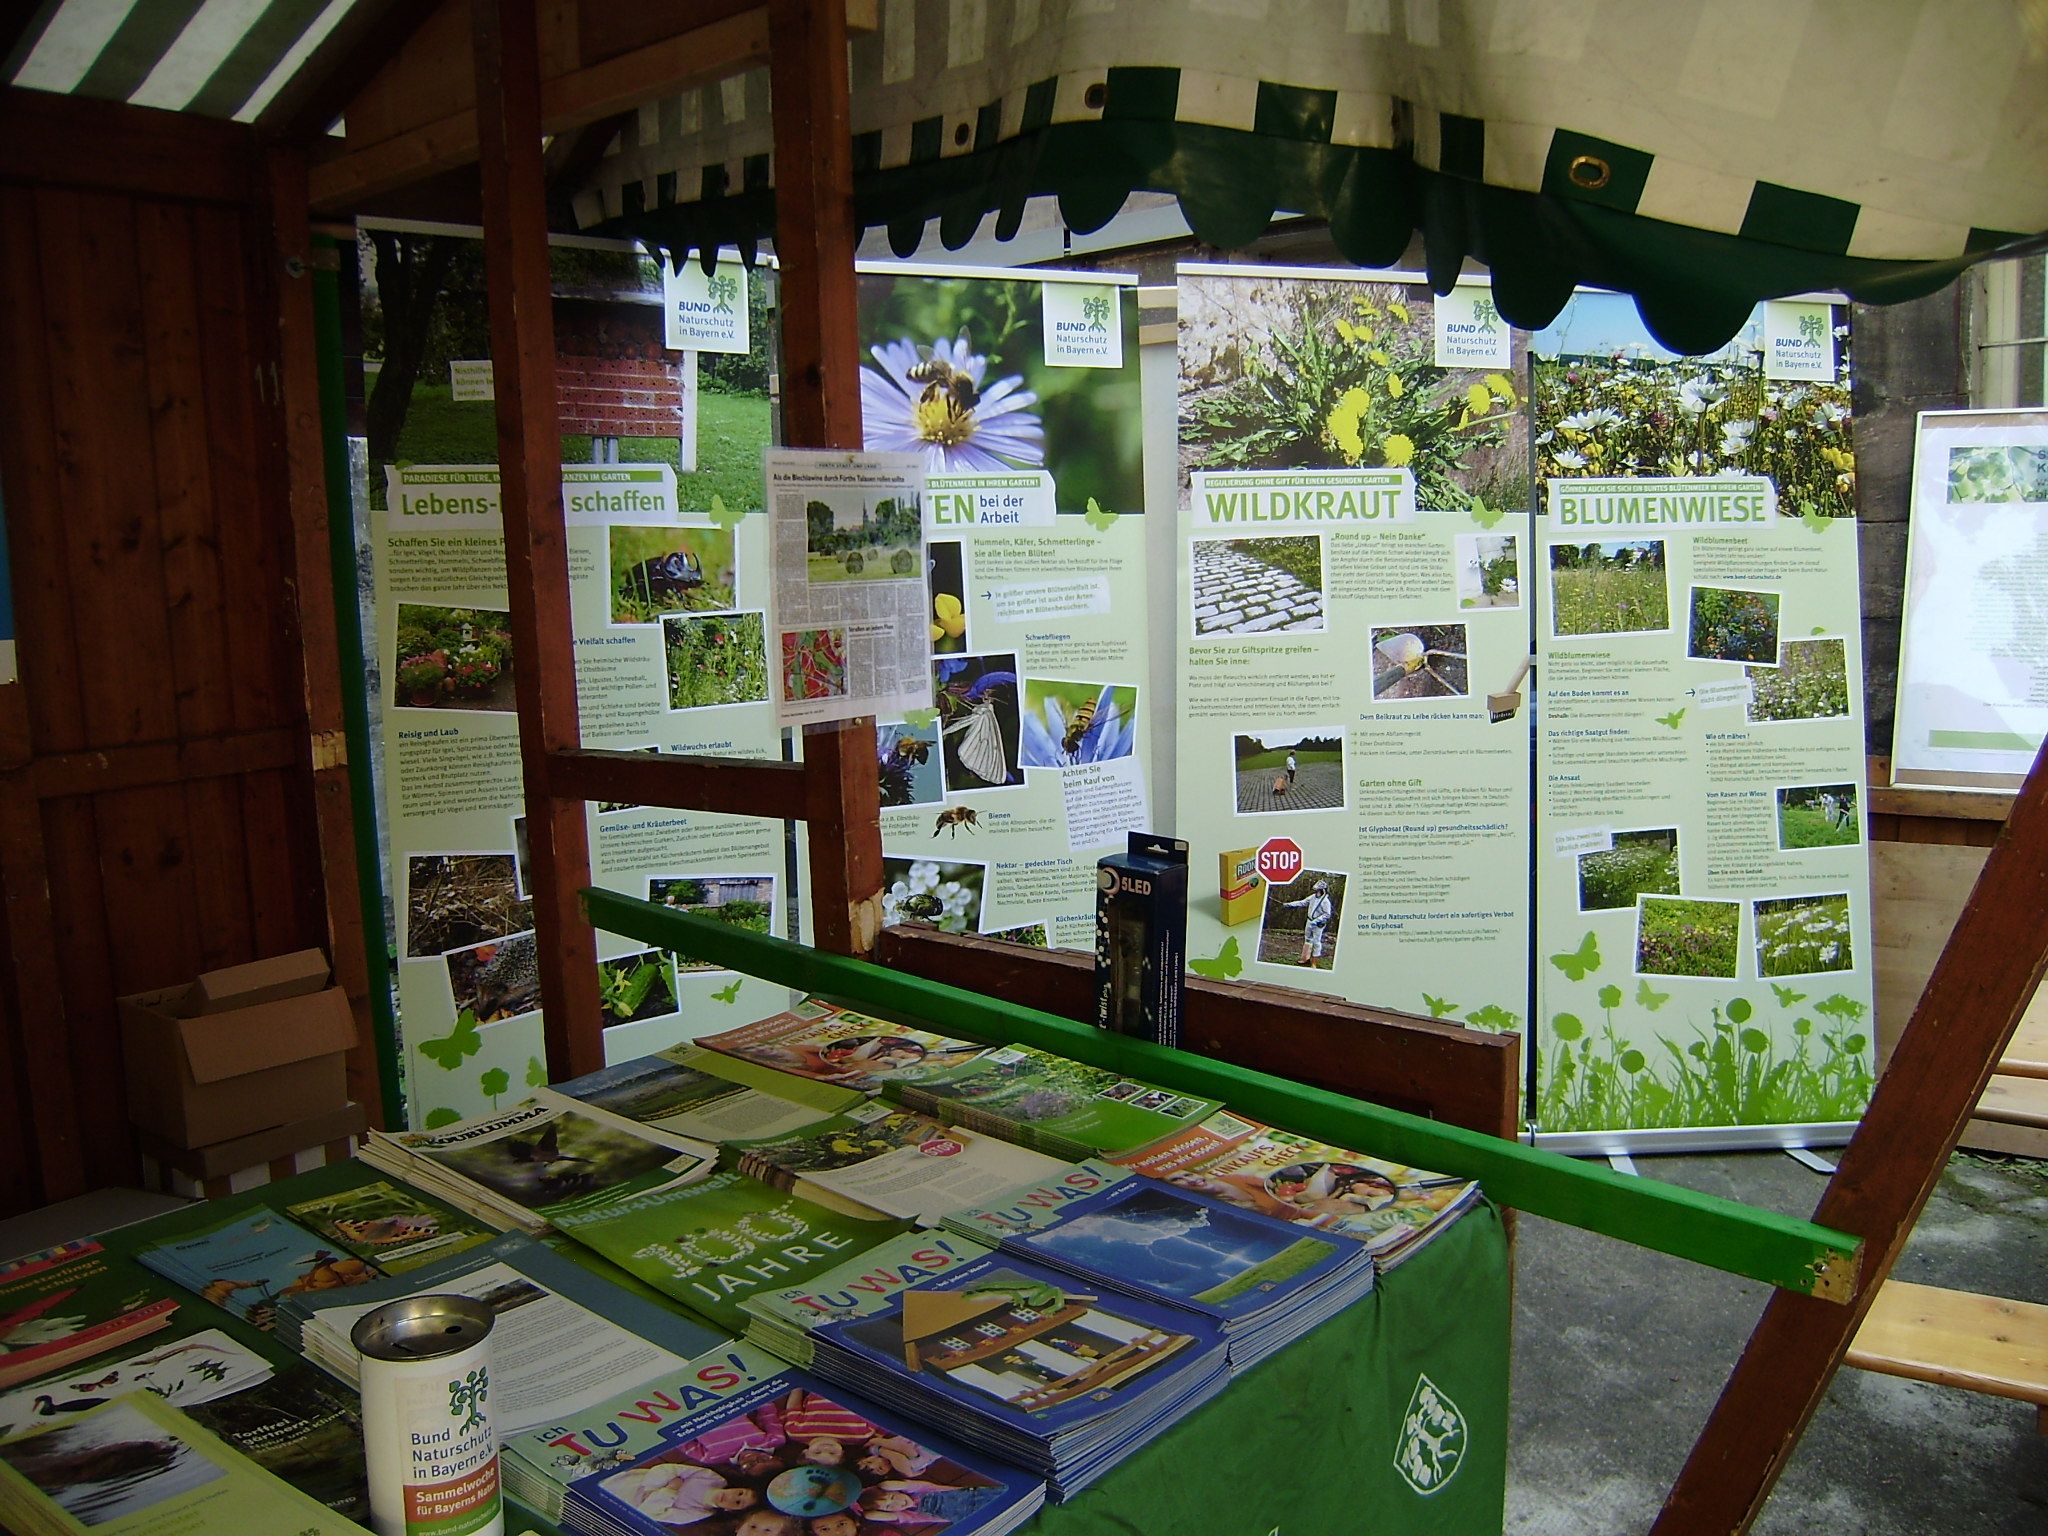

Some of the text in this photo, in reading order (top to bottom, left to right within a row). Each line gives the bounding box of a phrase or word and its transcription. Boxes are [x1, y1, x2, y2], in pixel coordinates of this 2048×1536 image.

[679, 301, 711, 312] BUND
[679, 314, 734, 327] Naturschutz
[679, 326, 734, 339] in Bayern e.V.
[1057, 323, 1086, 331] BUND
[1447, 324, 1476, 333] BUND
[1057, 334, 1107, 344] Naturschutz
[1447, 336, 1496, 345] Naturschutz
[1776, 339, 1802, 347] BUND
[1067, 346, 1094, 355] Bayern
[1456, 348, 1483, 356] Bayern
[1785, 361, 1809, 369] Bayern
[450, 473, 466, 482] FÜR
[931, 478, 1039, 488] BLÜTENMEER IN IHREM GARTEN!
[1205, 476, 1390, 487] REGULIERUNG OHNE GIFT FÜR EINEN GESUNDEN GARTEN
[402, 493, 496, 515] Lebens-
[572, 490, 665, 512] schaffen
[980, 495, 999, 507] bei
[1003, 495, 1024, 507] der
[1205, 490, 1402, 523] WILDKRAUT
[1560, 495, 1766, 525] BLUMENWIESE
[981, 512, 1019, 524] Arbeit
[388, 537, 497, 548] Schaffen Sie ein kleines
[974, 537, 1095, 548] Hummeln, Käfer, Schmetterlinge
[1693, 536, 1748, 545] Wildblumenbeet
[1028, 549, 1056, 557] Blüten!
[579, 637, 636, 645] Vielfalt schaffen
[1242, 646, 1283, 654] Giftspritze
[1285, 646, 1312, 655] greifen
[399, 731, 422, 739] Reisig
[440, 728, 458, 736] Laub
[671, 741, 732, 751] Wildwuchs erlaubt
[1062, 765, 1101, 778] Achten Sie
[1064, 775, 1115, 788] beim Kauf von
[600, 818, 687, 833] Gemüse- und Kräuterbeet
[1369, 825, 1401, 833] Glyphosat
[1438, 824, 1508, 832] gesundheitsschädlich?
[1261, 851, 1299, 869] STOP
[1388, 912, 1426, 920] Naturschutz
[1461, 911, 1493, 920] sofortiges
[1370, 922, 1404, 930] Glyphosat
[928, 1140, 955, 1156] STOP
[1263, 1142, 1311, 1168] CHECK
[976, 1165, 1112, 1226] TU WAS!
[692, 1231, 853, 1301] JAHRE
[791, 1240, 965, 1312] TU WAS!
[779, 1288, 806, 1301] ich
[548, 1421, 629, 1456] TU
[617, 1353, 758, 1424] WAS!
[412, 1428, 451, 1445] Bund
[534, 1426, 569, 1443] ich
[412, 1426, 492, 1462] Naturschutz
[414, 1468, 427, 1478] in
[432, 1455, 477, 1477] Bayern
[416, 1467, 495, 1503] Sammelwoche
[417, 1480, 496, 1515] für Bayerns Natur
